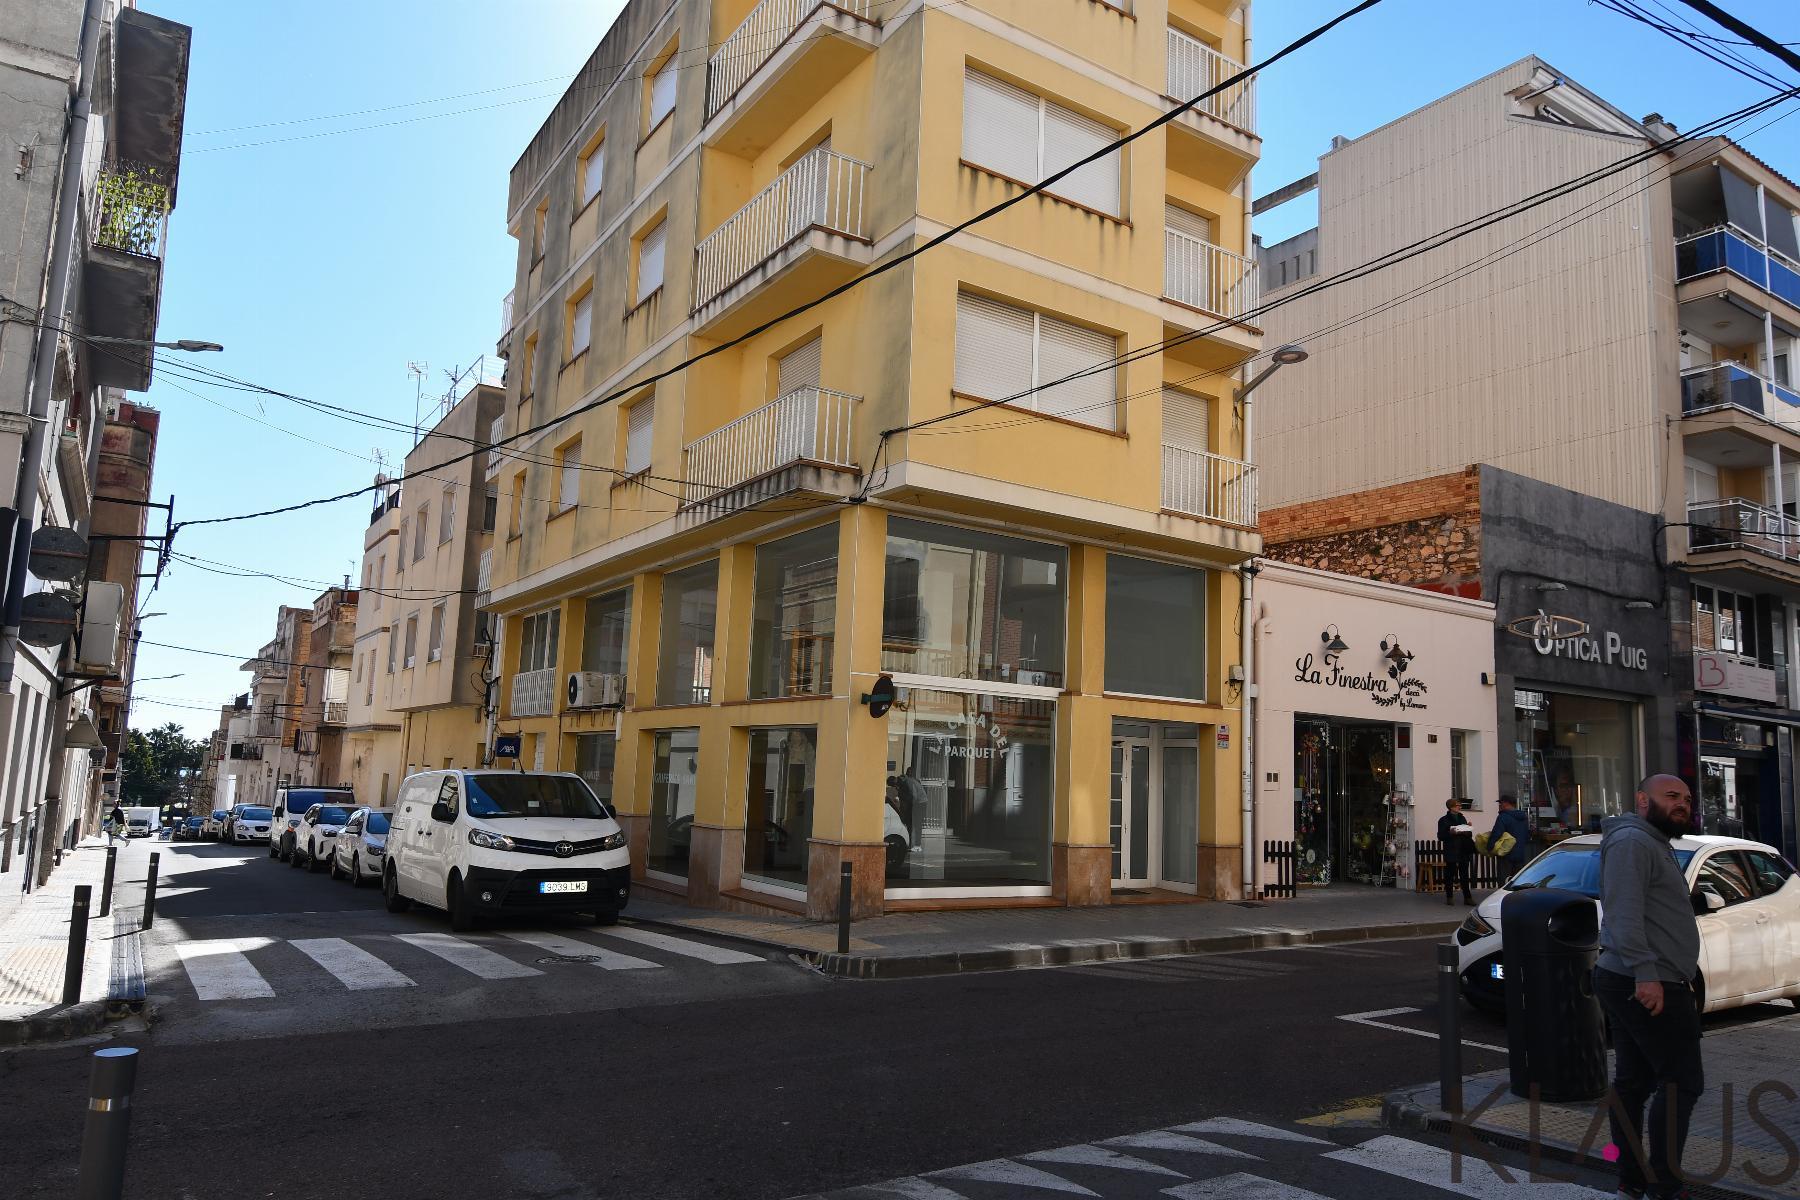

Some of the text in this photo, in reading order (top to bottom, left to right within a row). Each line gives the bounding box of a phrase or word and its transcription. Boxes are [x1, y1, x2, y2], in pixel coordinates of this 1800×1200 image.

[1605, 631, 1647, 671] PUIG
[1295, 653, 1388, 692] La Finestra
[944, 745, 997, 760] PARQUET
[947, 712, 986, 730] CASA
[989, 724, 1010, 759] DEL
[546, 881, 586, 892] 9039 LMS
